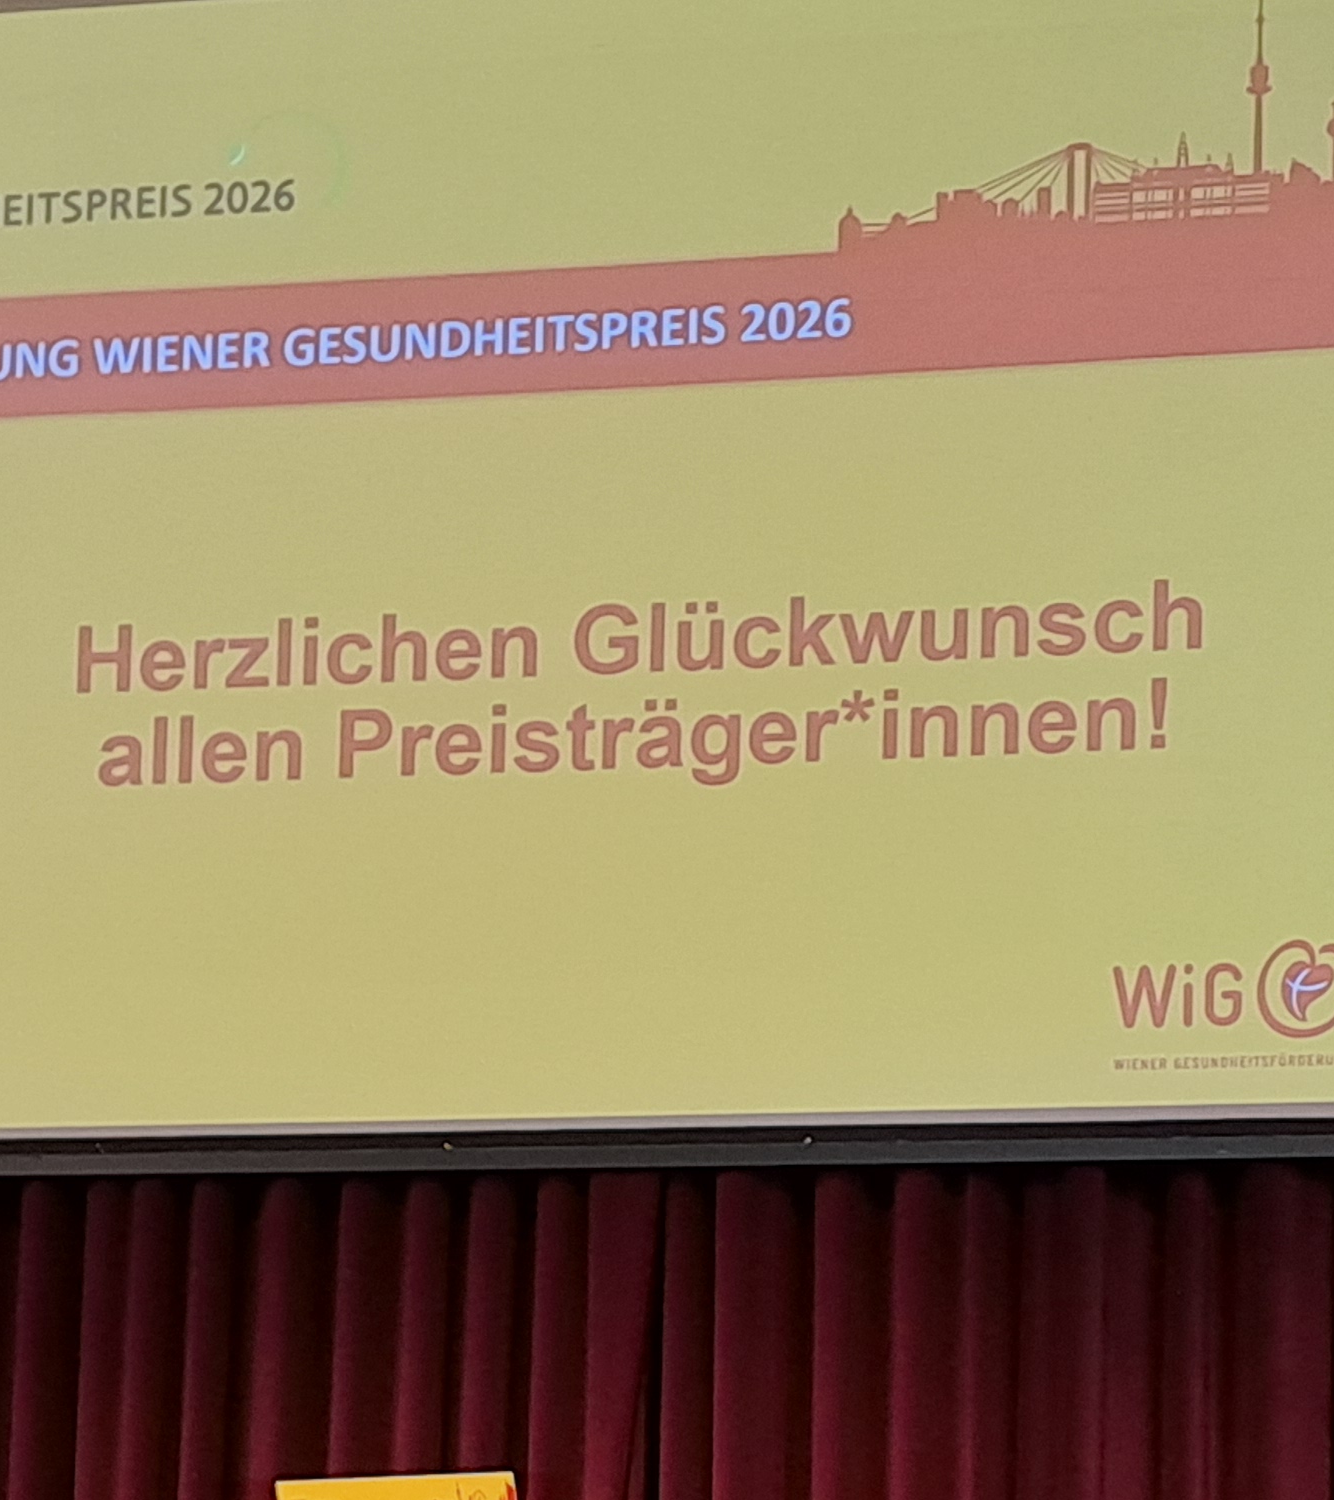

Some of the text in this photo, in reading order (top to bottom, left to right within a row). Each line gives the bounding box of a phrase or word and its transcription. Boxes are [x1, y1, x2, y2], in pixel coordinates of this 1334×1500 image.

[203, 179, 295, 216] 2026
[94, 331, 271, 376] WIENER
[282, 306, 727, 367] GESUNDHEITSPREIS
[741, 298, 853, 343] 2026
[75, 579, 1204, 693] Herzlichen Glückwunsch
[98, 715, 302, 787] allen
[1113, 963, 1243, 1029] WiG
[1113, 1058, 1167, 1071] WIENER
